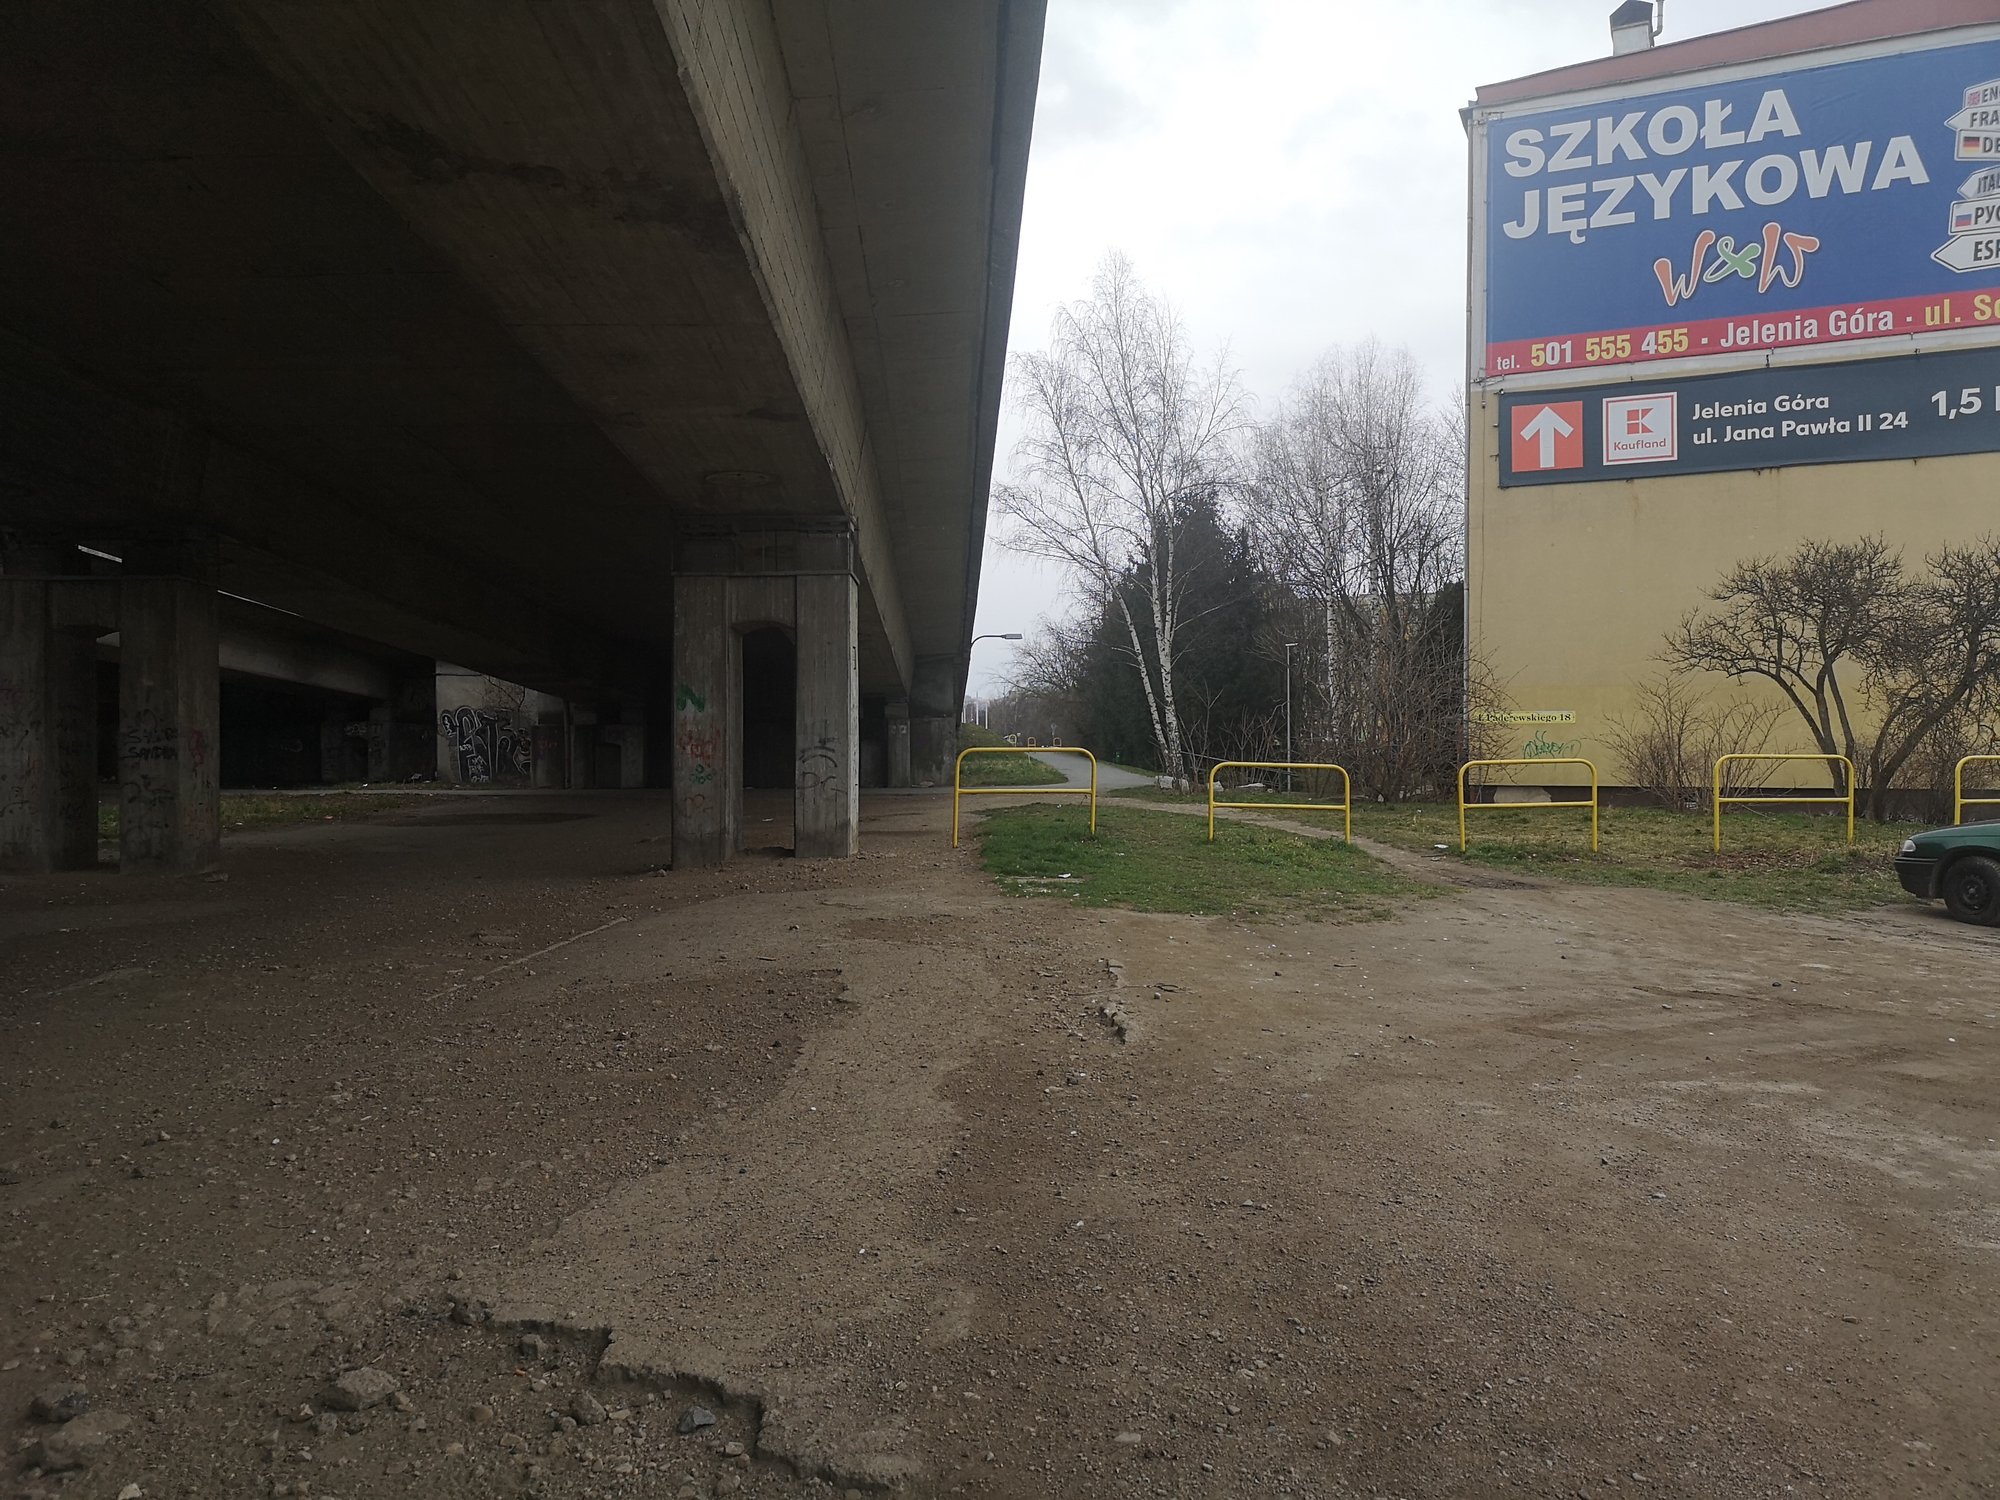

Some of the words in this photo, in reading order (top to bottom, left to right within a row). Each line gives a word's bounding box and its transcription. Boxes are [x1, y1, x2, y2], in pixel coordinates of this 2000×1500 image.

[1503, 88, 1801, 178] SZKOŁA
[1502, 135, 1930, 245] JĘZYKOWA
[1653, 222, 1820, 307] W&W
[1496, 355, 1520, 370] tel.
[1530, 340, 1572, 367] 501
[1585, 334, 1632, 361] 555
[1641, 327, 1689, 354] 455
[1720, 315, 1818, 348] Jelenia
[1828, 307, 1893, 336] Góra
[1925, 299, 1961, 326] ul.
[1692, 399, 1767, 420] Jelenia
[1774, 394, 1829, 412] Góra
[1931, 387, 1982, 420] 1,5
[1613, 438, 1667, 451] Kaufland
[1693, 427, 1718, 445] ul.
[1723, 425, 1774, 443] Jana
[1781, 417, 1850, 437] Pawła
[1857, 414, 1872, 432] II
[1879, 411, 1908, 430] 24
[1560, 713, 1571, 721] 18
